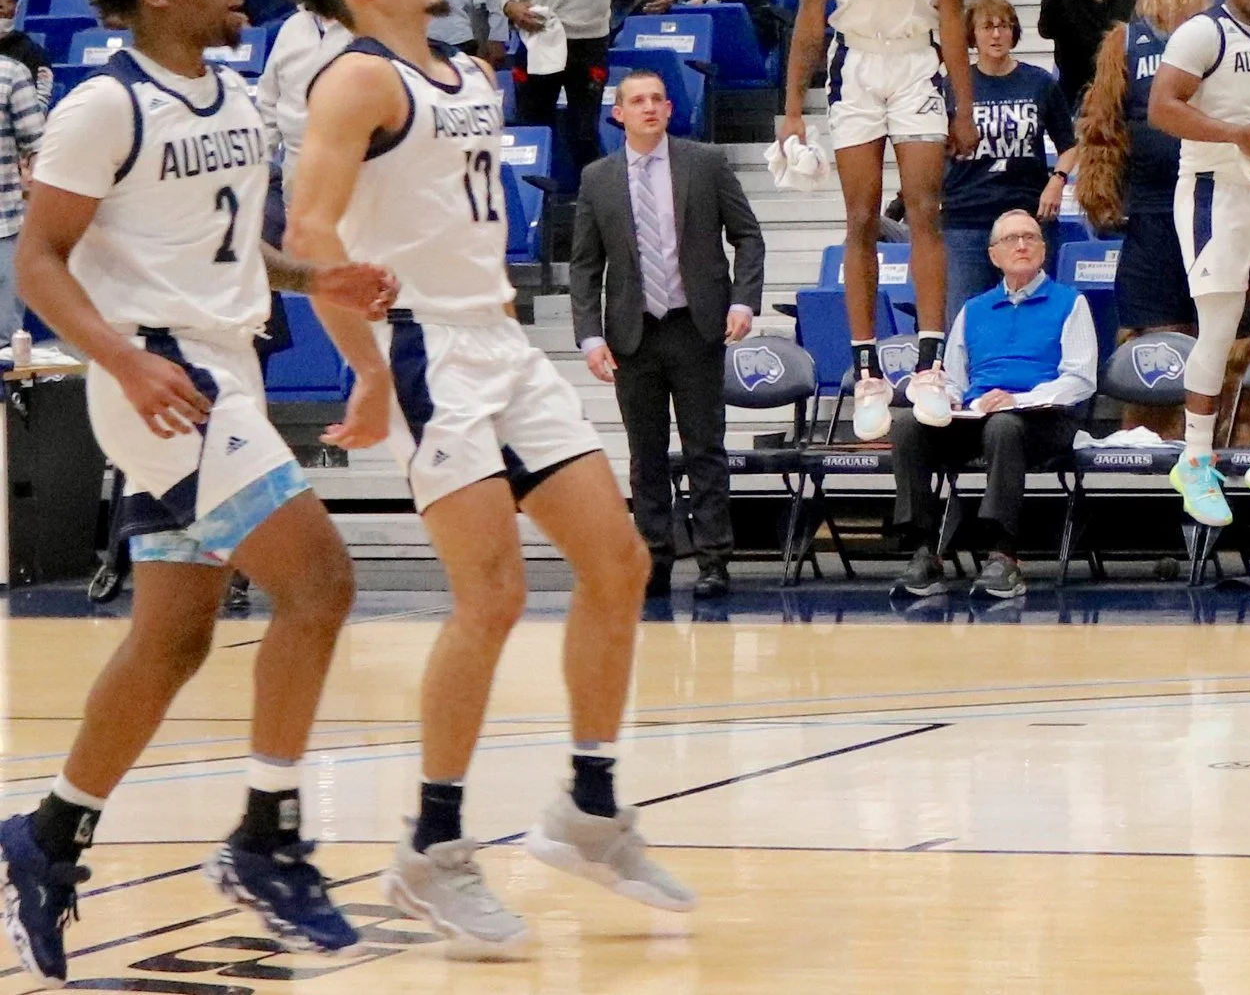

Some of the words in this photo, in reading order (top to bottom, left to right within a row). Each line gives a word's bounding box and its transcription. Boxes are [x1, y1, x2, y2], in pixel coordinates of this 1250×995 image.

[464, 150, 500, 222] 12
[214, 186, 239, 263] 2
[823, 455, 879, 467] JAGUARS
[1094, 453, 1153, 466] JAGUARS
